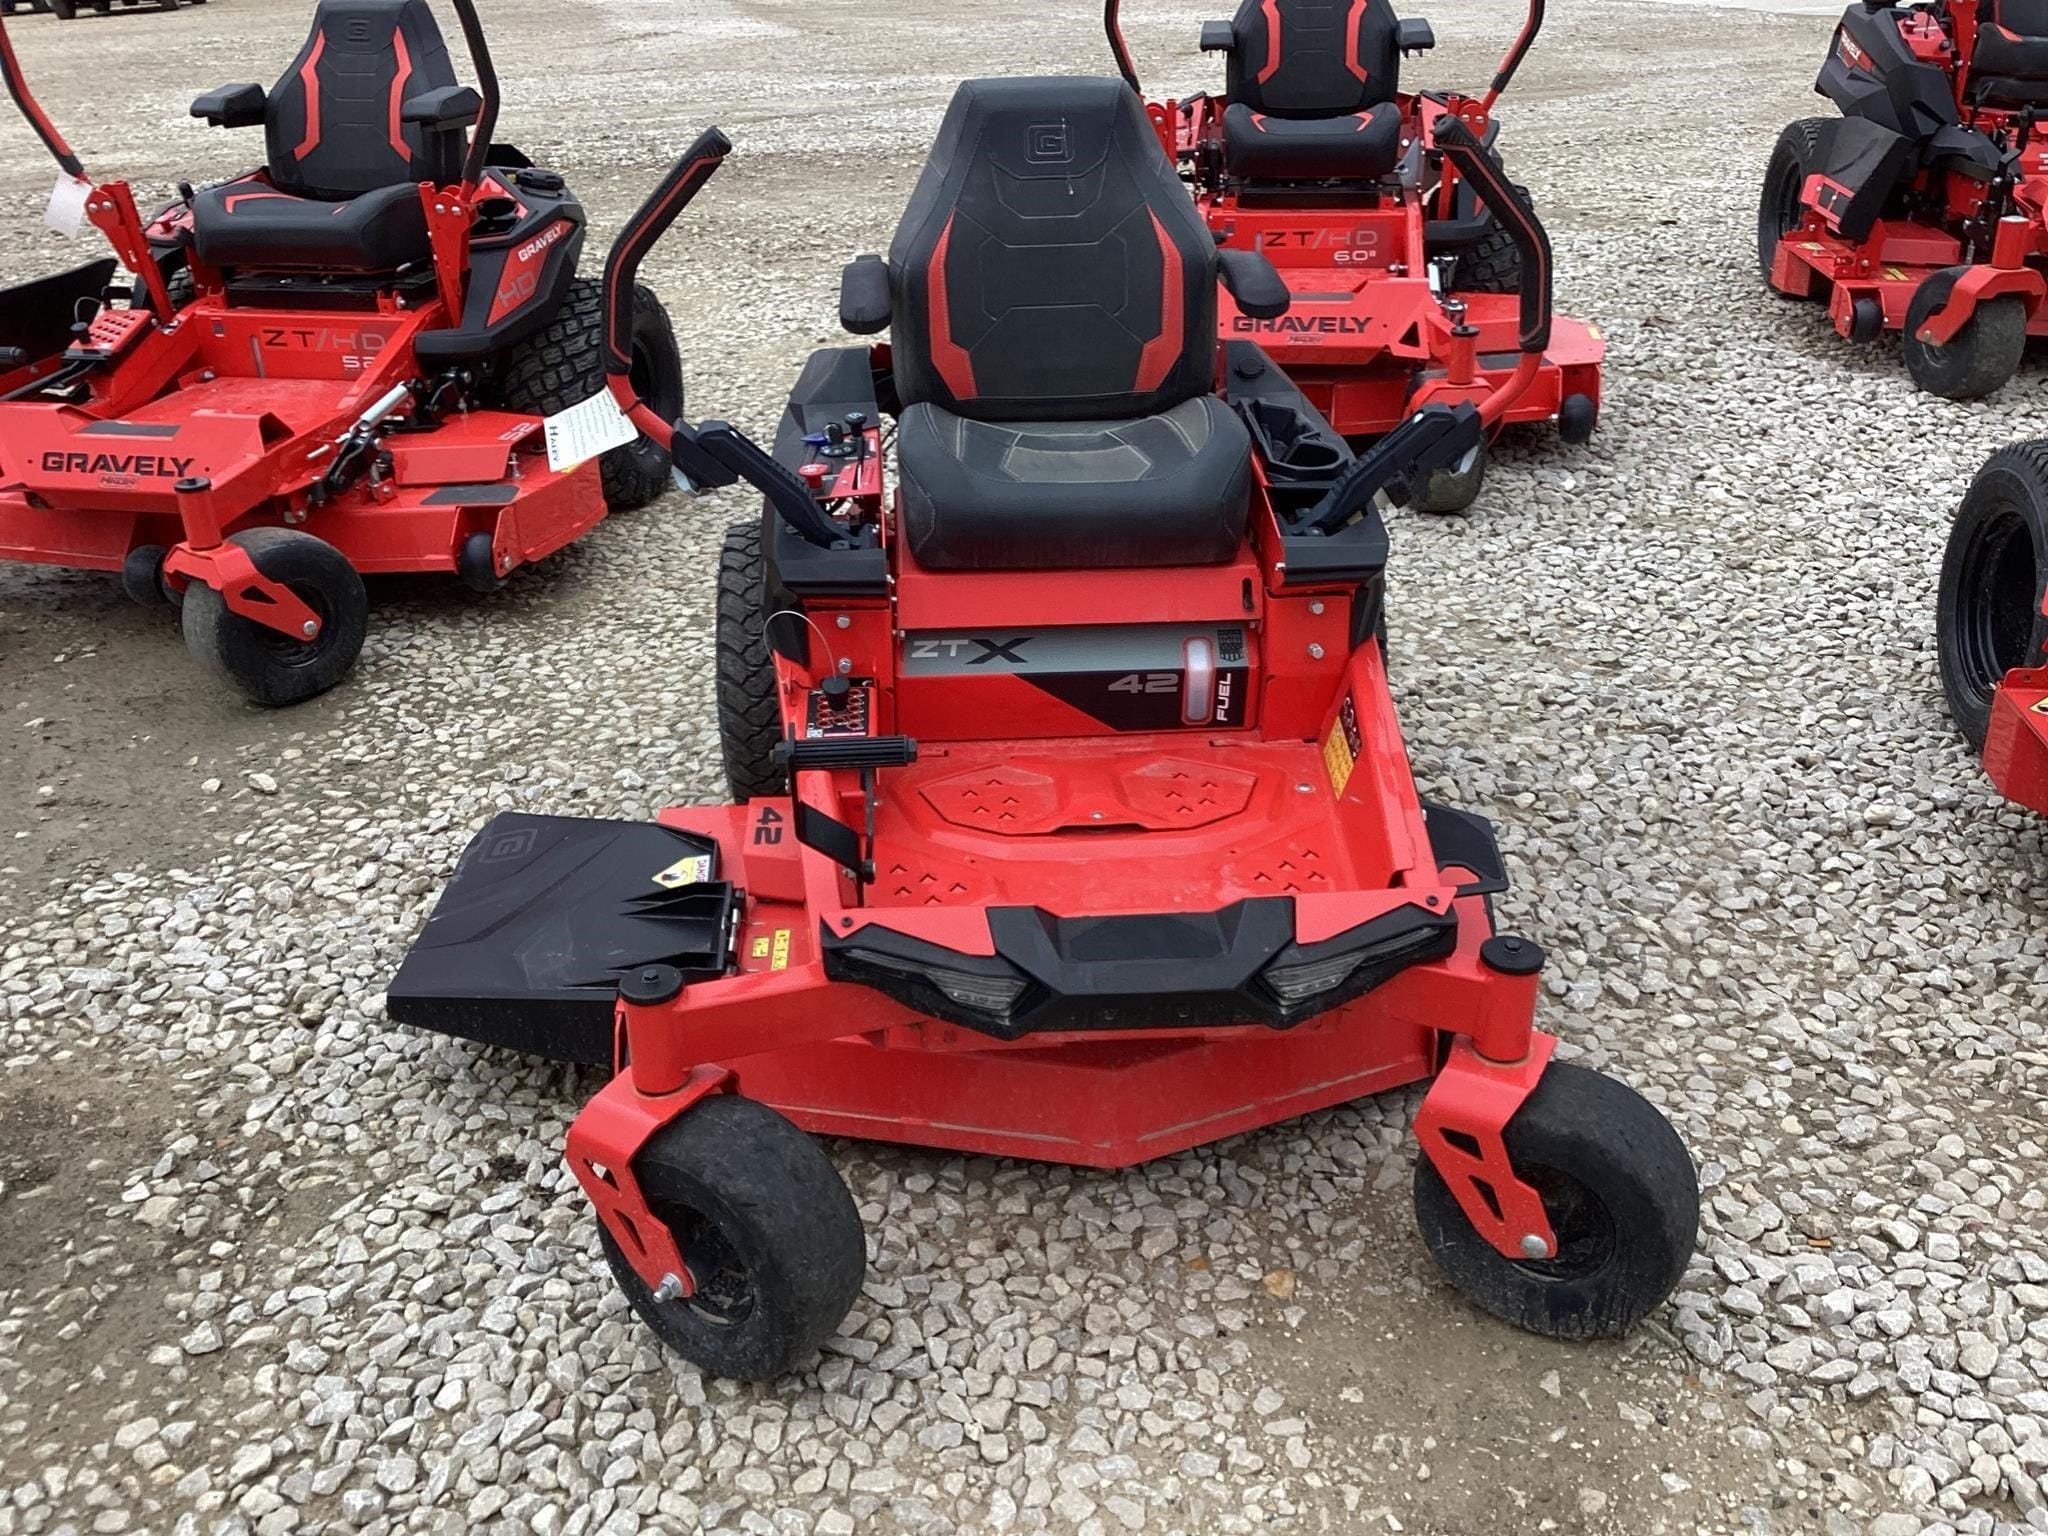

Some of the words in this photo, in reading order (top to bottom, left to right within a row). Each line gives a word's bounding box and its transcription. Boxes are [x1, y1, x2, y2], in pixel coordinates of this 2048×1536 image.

[518, 223, 561, 262] GRAVELY
[1265, 228, 1378, 249] ZT/HD
[499, 272, 536, 307] HD
[1233, 316, 1373, 333] GRAVELY
[263, 328, 385, 352] ZT/HD
[497, 422, 540, 442] 52
[42, 452, 194, 477] GRAVELY
[911, 637, 1034, 665] ZTX
[1108, 673, 1179, 694] 42
[1216, 672, 1232, 721] FUEL
[753, 806, 784, 845] 42
[696, 858, 708, 883] DANGE
